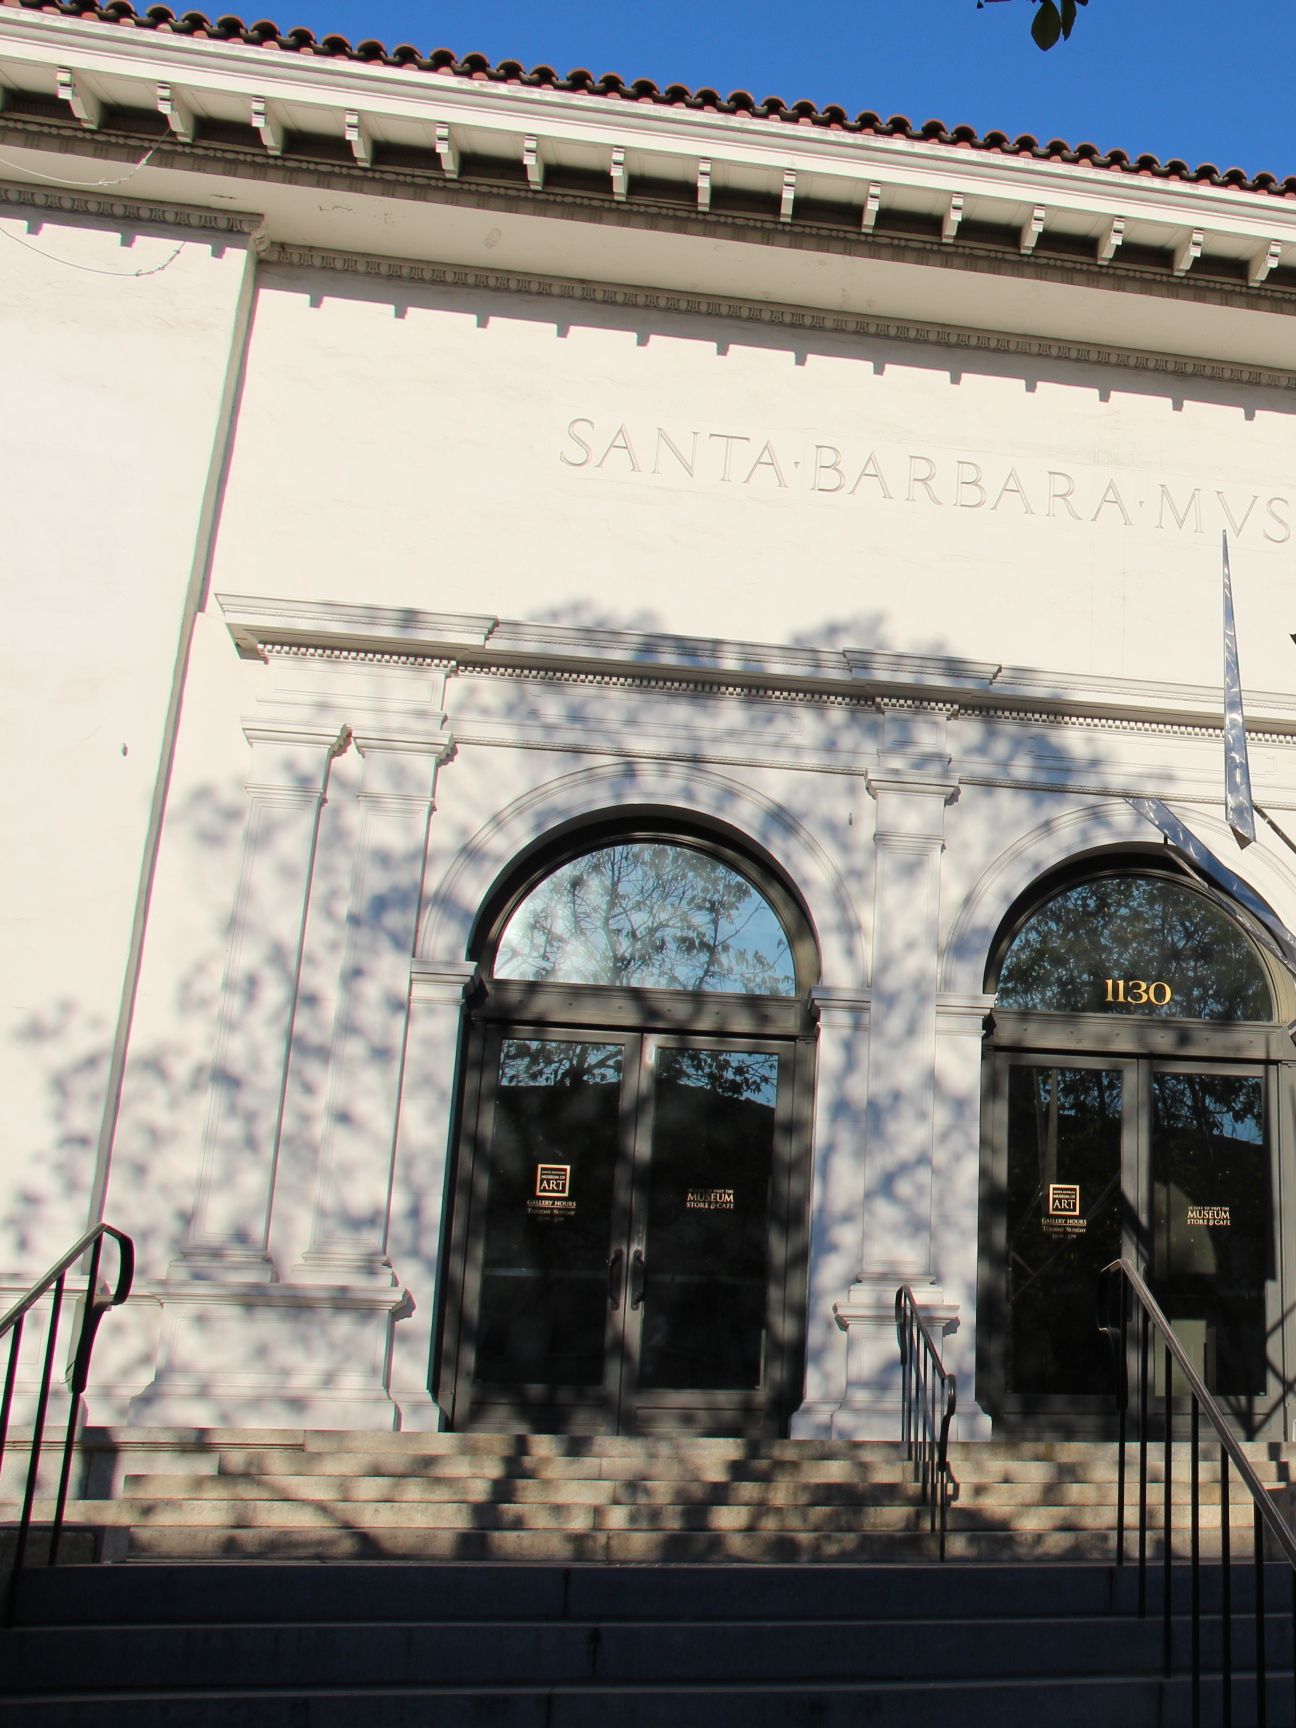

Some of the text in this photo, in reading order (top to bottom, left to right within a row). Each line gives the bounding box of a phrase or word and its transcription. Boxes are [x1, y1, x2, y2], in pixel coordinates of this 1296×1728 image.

[559, 417, 789, 488] SANTA
[809, 444, 1134, 527] BARBARA
[1105, 979, 1172, 1005] 1130
[540, 1179, 566, 1191] ART
[687, 1192, 735, 1203] MUSEUM
[686, 1201, 709, 1209] STORE
[1053, 1199, 1076, 1210] ART
[1187, 1209, 1231, 1219] MUSEUM
